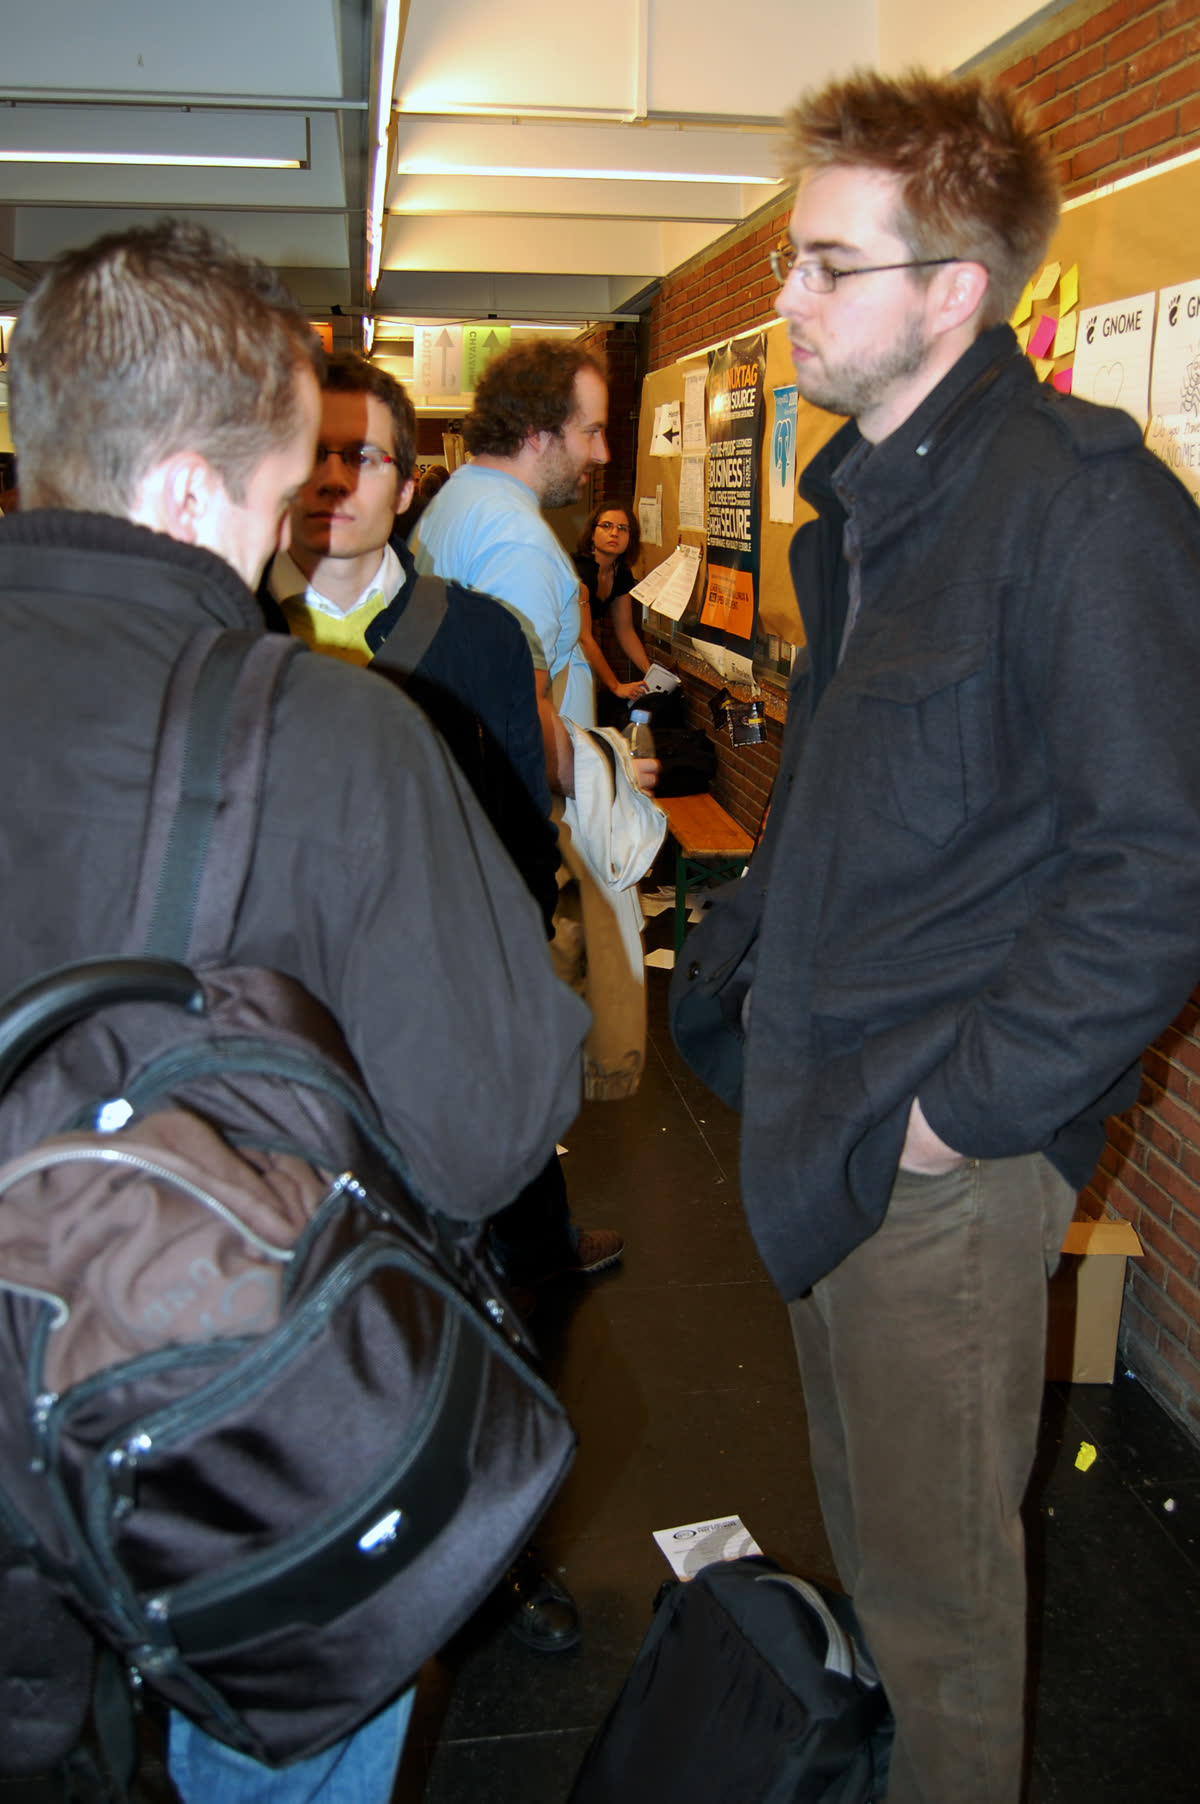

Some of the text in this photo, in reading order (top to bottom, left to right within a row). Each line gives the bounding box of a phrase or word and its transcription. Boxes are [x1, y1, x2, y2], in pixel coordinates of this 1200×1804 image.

[1102, 311, 1142, 337] GNOME
[731, 387, 756, 410] SOURCE
[709, 458, 743, 488] BUSINESS
[721, 507, 752, 540] SECURE
